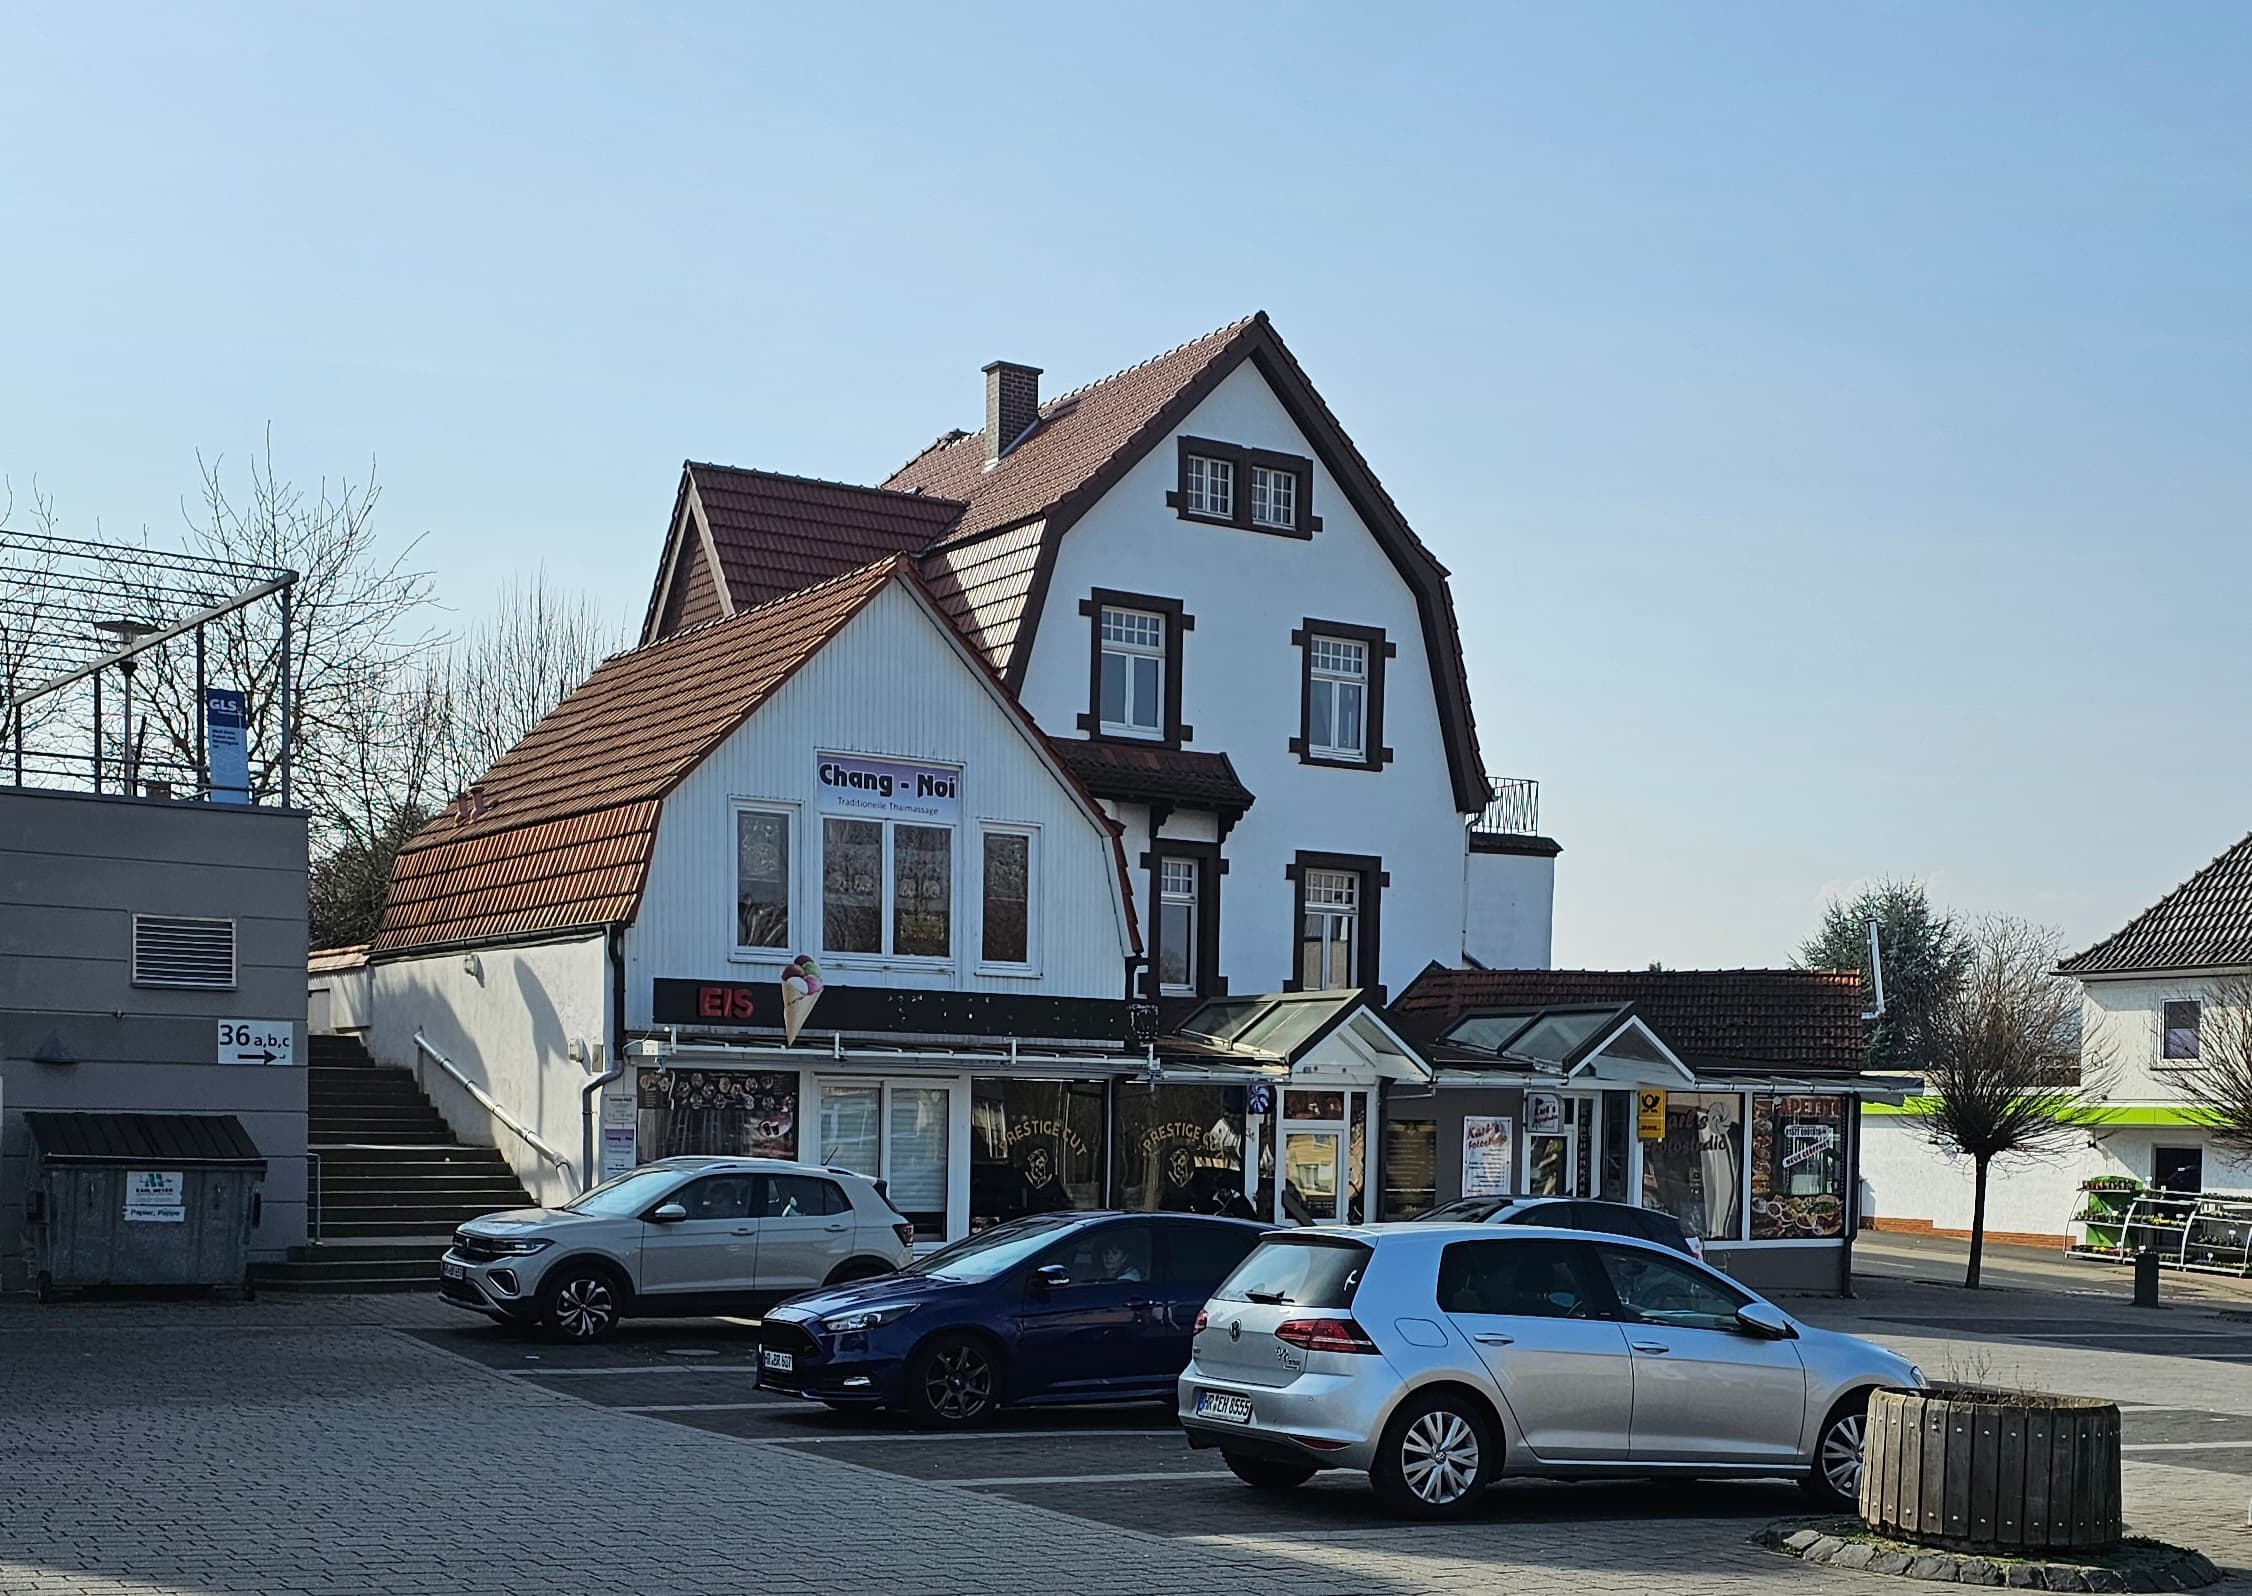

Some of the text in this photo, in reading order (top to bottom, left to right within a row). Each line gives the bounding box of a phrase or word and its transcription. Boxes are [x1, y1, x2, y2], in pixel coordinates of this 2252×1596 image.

[209, 699, 237, 711] GLS
[819, 763, 893, 798] Chang
[917, 773, 956, 798] Noi
[838, 797, 938, 816] Traditionelle Thaimassage
[699, 987, 754, 1018] EIS
[219, 1024, 290, 1049] 36 a,b,c
[999, 1119, 1087, 1156] PRESTIGE CUT
[1142, 1121, 1201, 1152] PRESTIGE
